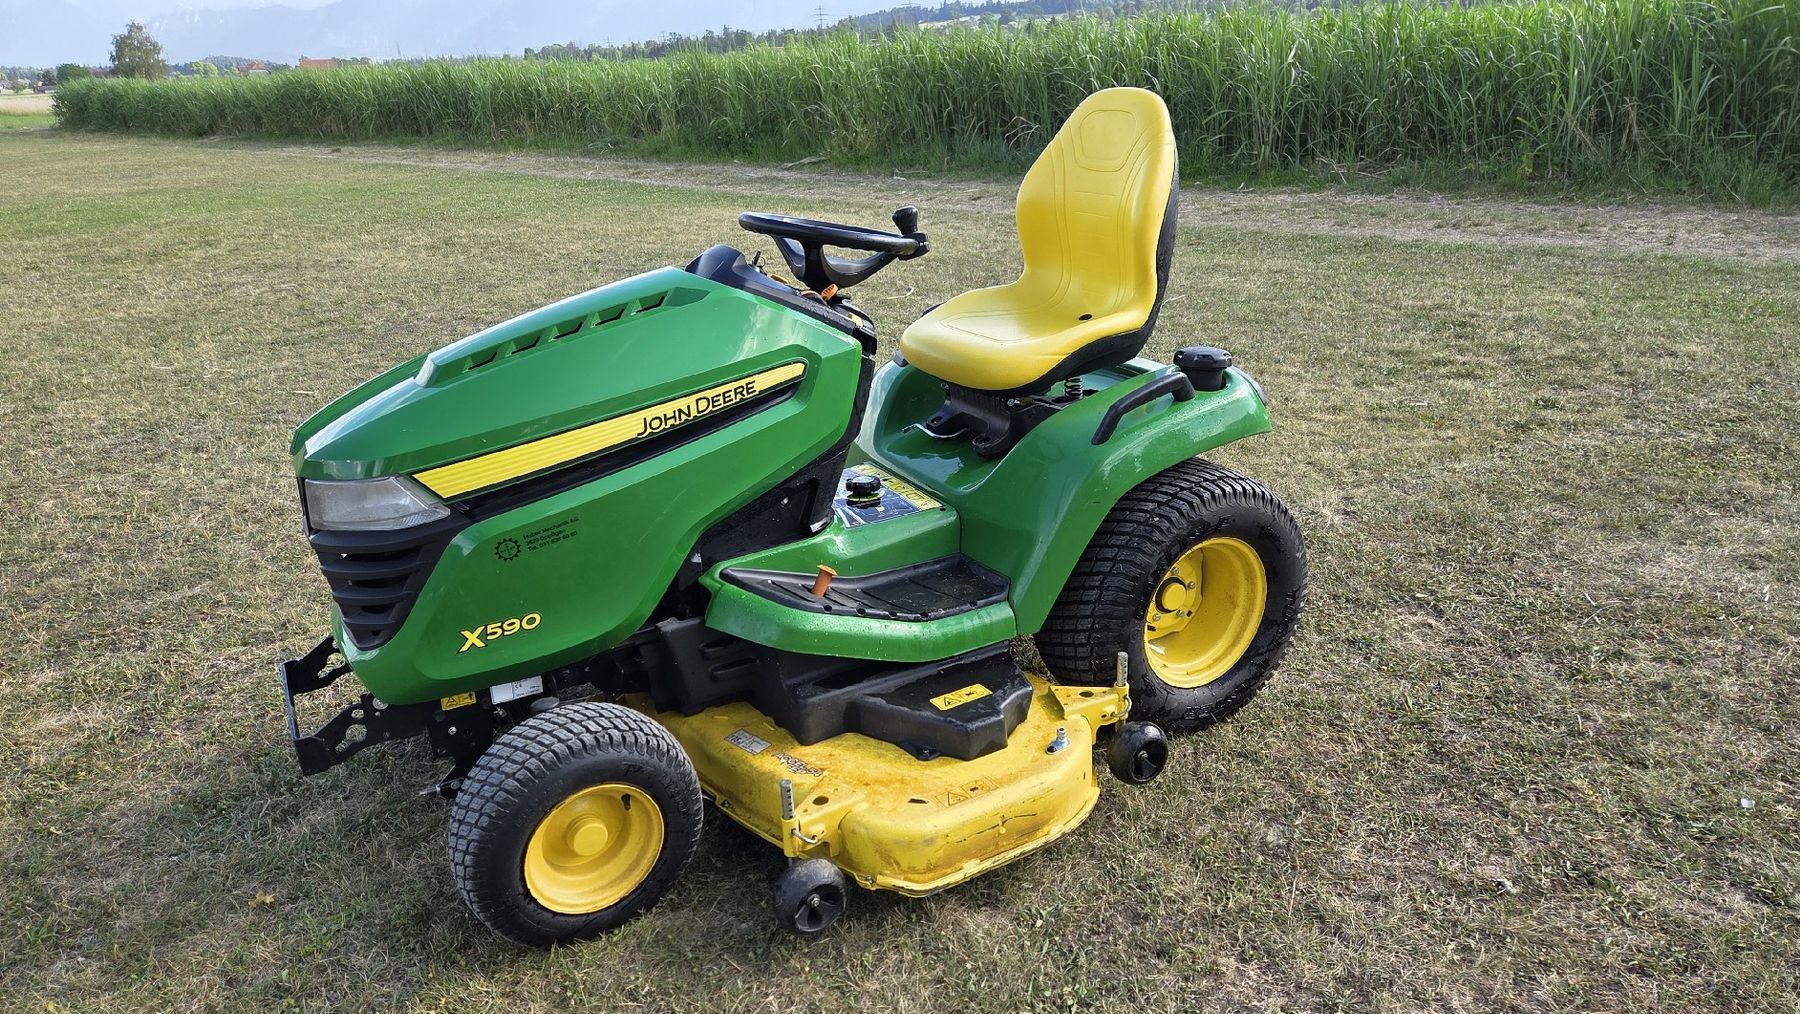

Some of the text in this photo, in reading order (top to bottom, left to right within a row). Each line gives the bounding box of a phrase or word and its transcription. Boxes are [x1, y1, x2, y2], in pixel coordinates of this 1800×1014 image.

[637, 380, 757, 436] JOHN DEERE
[457, 612, 542, 653] X590
